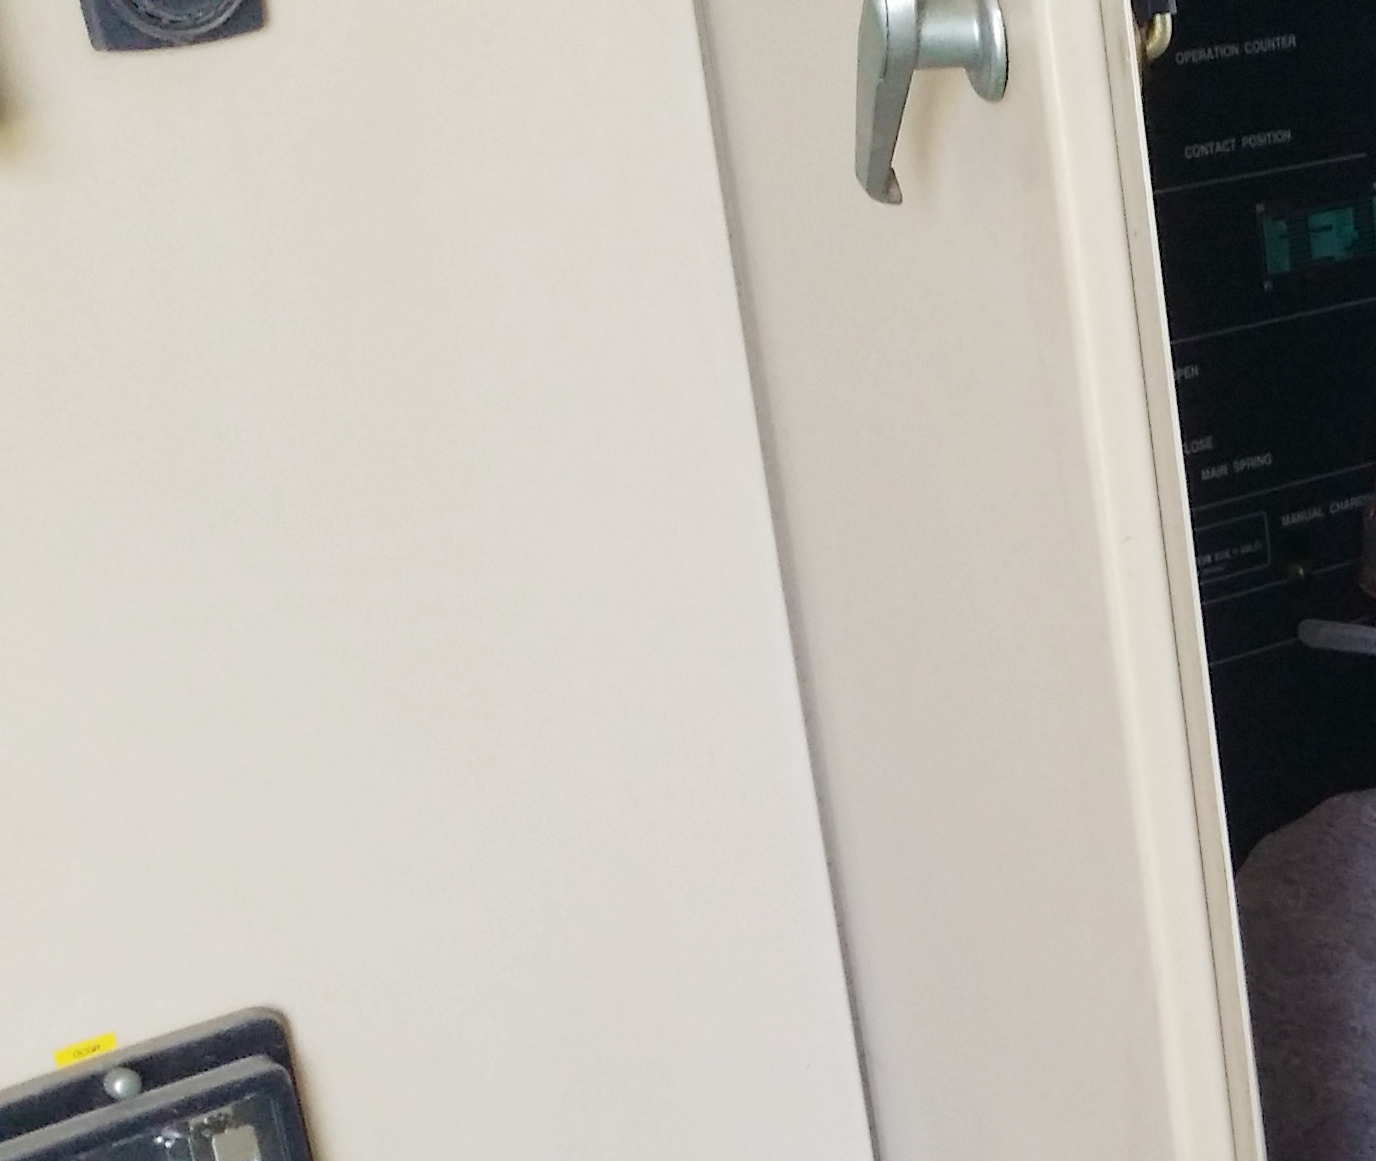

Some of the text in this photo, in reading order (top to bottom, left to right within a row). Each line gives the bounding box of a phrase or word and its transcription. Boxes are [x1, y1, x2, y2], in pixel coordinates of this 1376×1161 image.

[1175, 33, 1297, 66] OPERATION COUNTER
[1184, 129, 1292, 160] CONTACT POSITION
[1184, 435, 1214, 456] LOSE
[1232, 452, 1273, 473] SPRING
